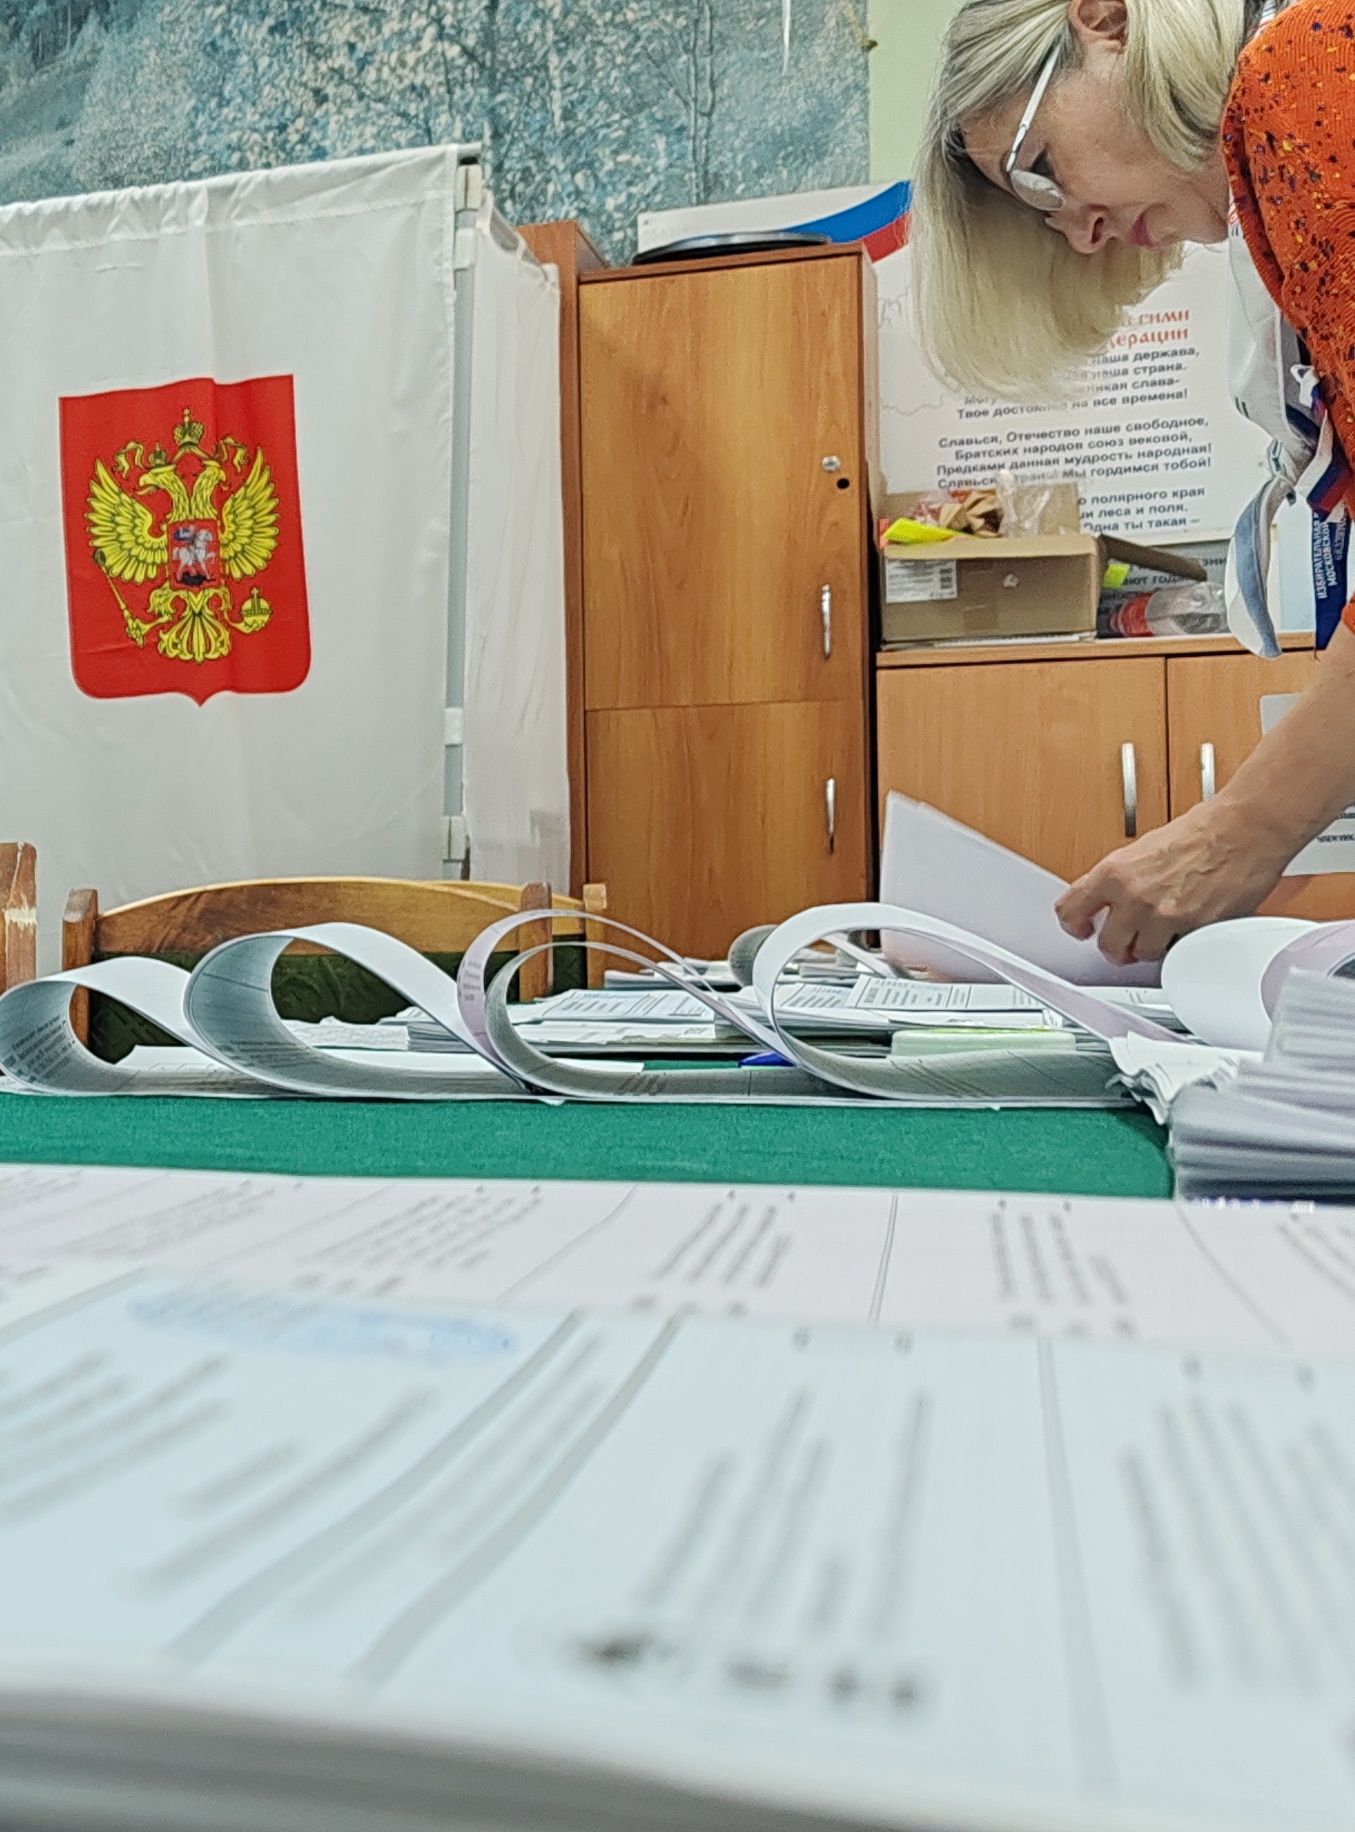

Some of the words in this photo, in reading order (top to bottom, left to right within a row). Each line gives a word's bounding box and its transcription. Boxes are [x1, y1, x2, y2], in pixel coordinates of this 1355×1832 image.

[1132, 347, 1200, 362] держава,
[1093, 396, 1117, 407] все
[1122, 388, 1188, 405] времена!
[938, 435, 1002, 448] Славься,
[1006, 428, 1080, 443] Отечество
[1084, 424, 1121, 436] наше
[1125, 417, 1209, 433] свободное,
[955, 447, 1019, 461] Братских
[1023, 441, 1083, 455] народов
[1088, 438, 1124, 449] союз
[1129, 431, 1192, 447] вековой,
[937, 461, 1006, 476] Предками
[1009, 457, 1059, 470] данная
[1064, 451, 1133, 467] мудрость
[1137, 442, 1211, 459] народная!
[1091, 463, 1159, 477] гордимся
[1163, 456, 1211, 471] тобой!
[1091, 489, 1167, 505] полярного
[1172, 486, 1205, 500] края
[1098, 507, 1131, 518] леса
[1136, 506, 1144, 515] и
[1149, 503, 1188, 515] поля.
[1123, 521, 1143, 530] ты
[1147, 517, 1187, 529] такая
